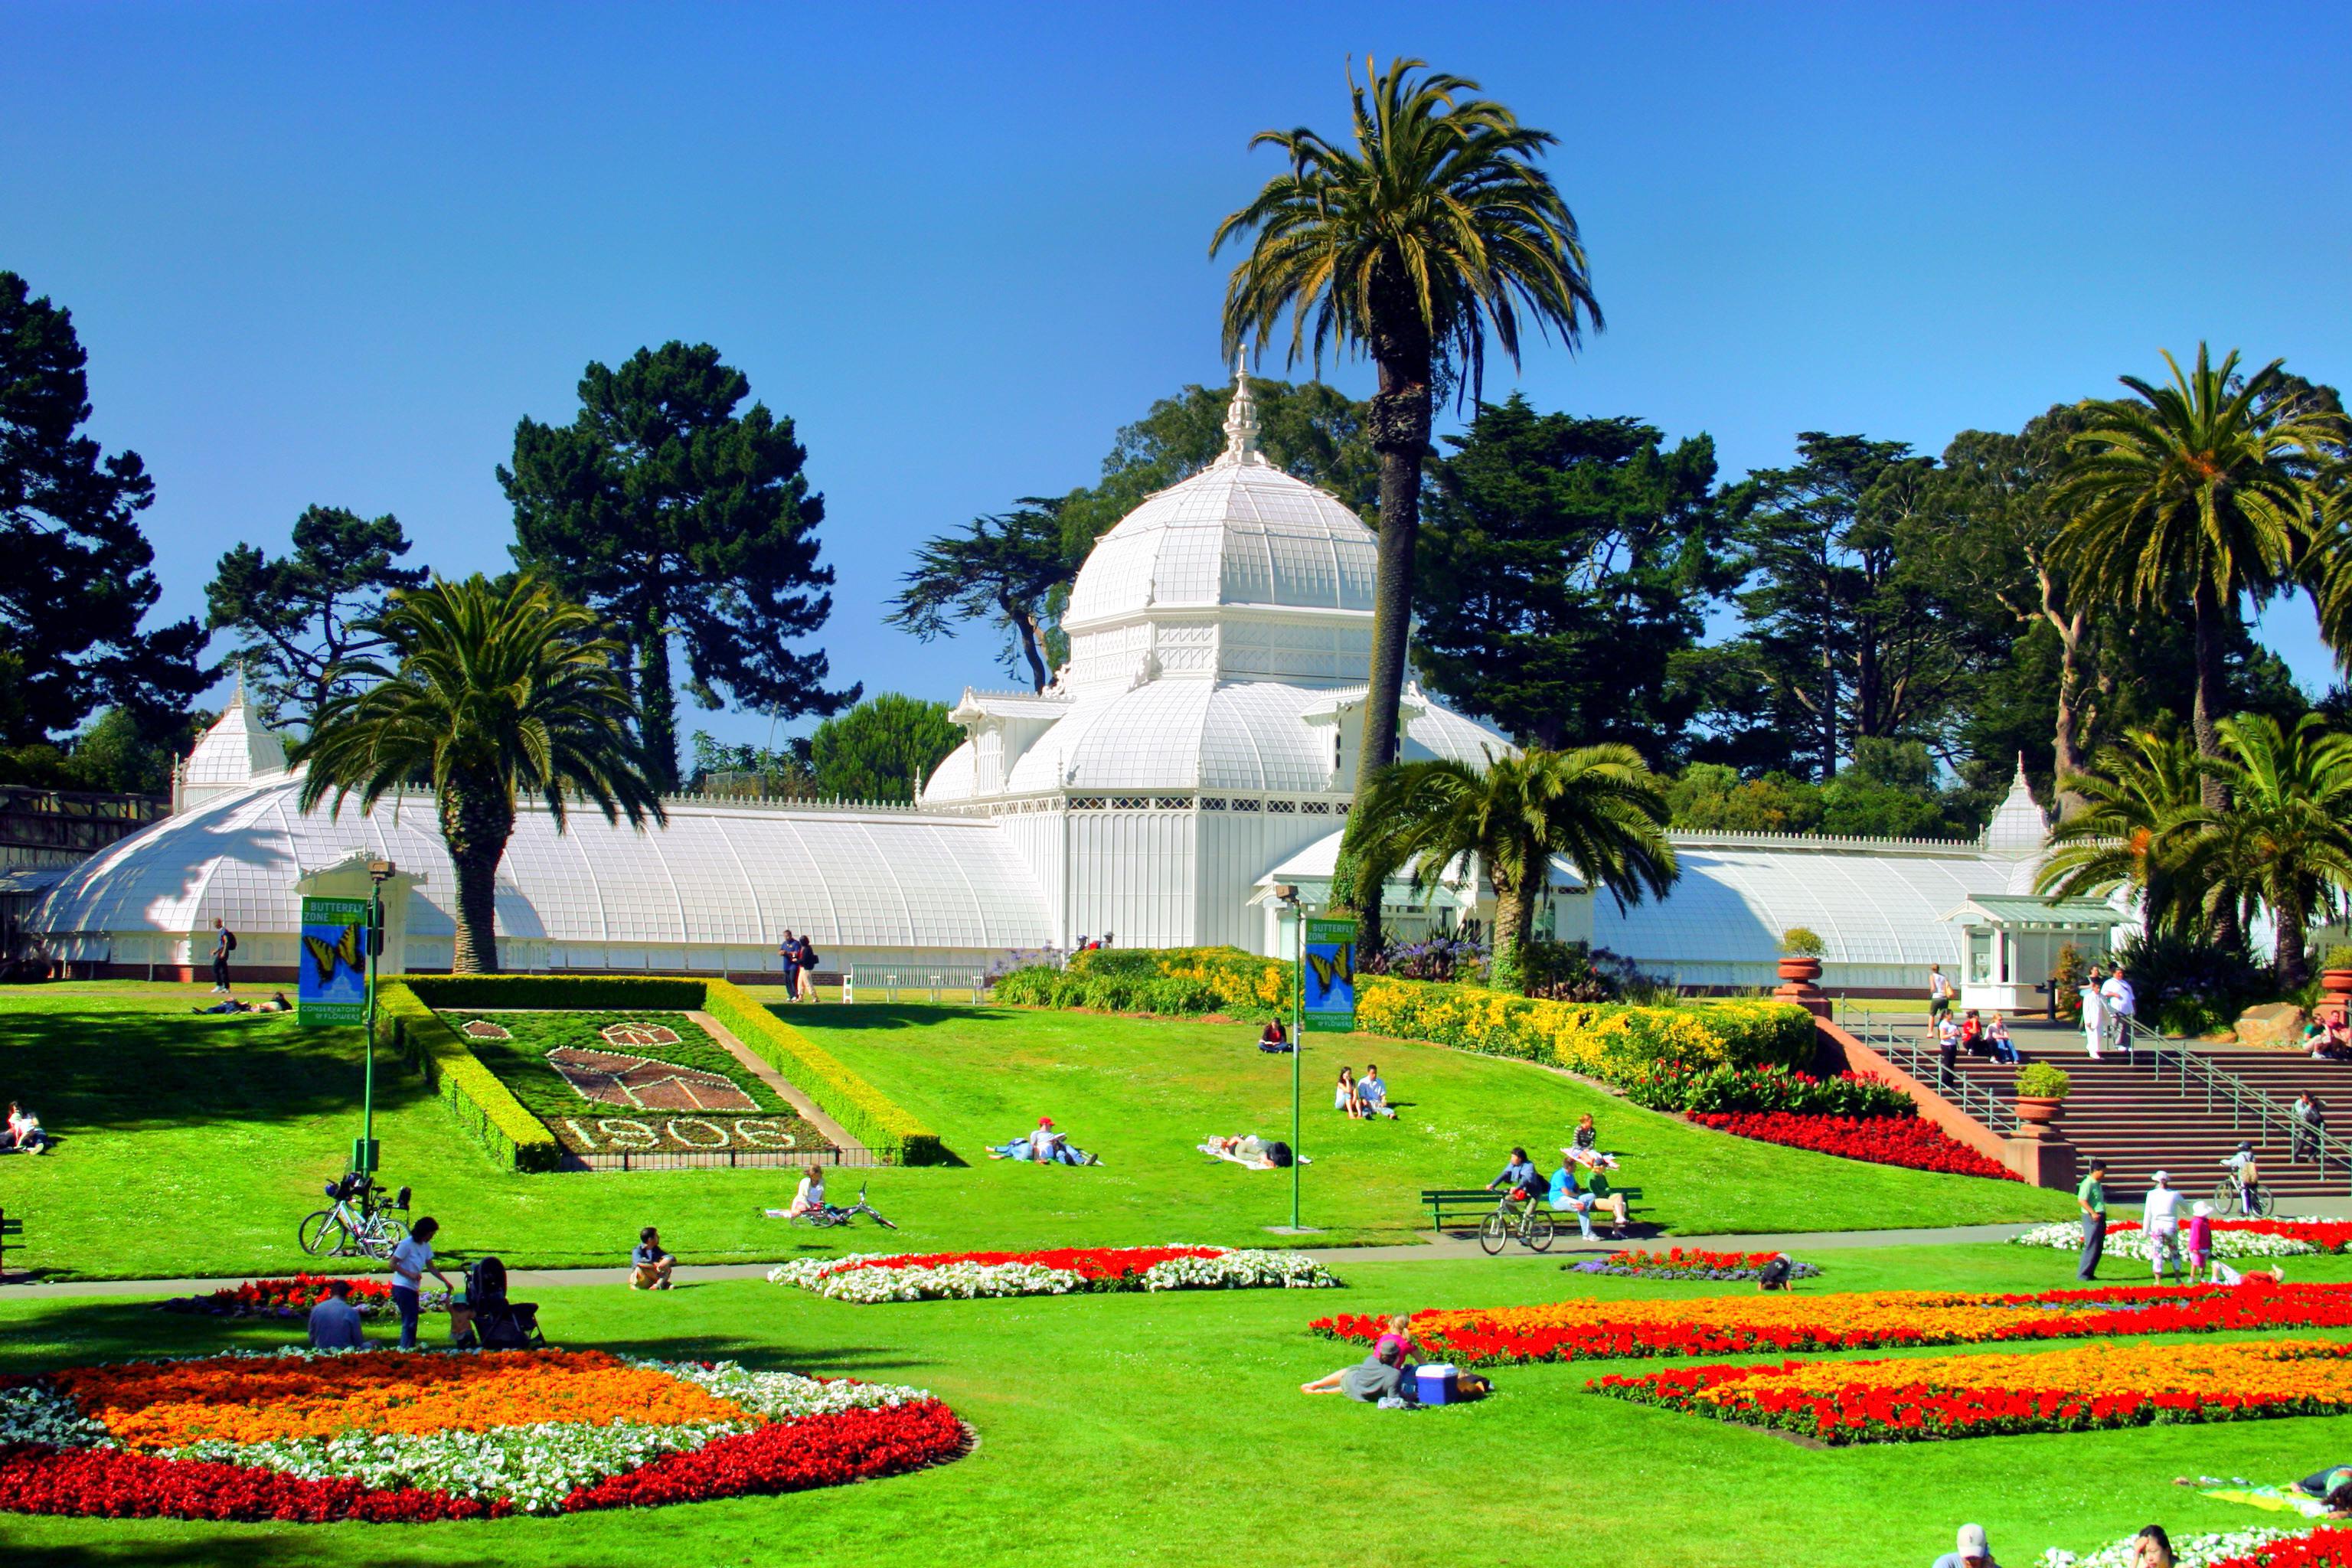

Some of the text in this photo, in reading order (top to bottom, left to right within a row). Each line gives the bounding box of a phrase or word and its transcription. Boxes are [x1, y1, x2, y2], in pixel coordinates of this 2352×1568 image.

[310, 902, 364, 913] BUTTERFLY
[304, 913, 329, 922] ZONE
[1312, 923, 1354, 933] BUTTERFLY
[1307, 933, 1328, 941] ZONE
[565, 1118, 796, 1148] 1906
